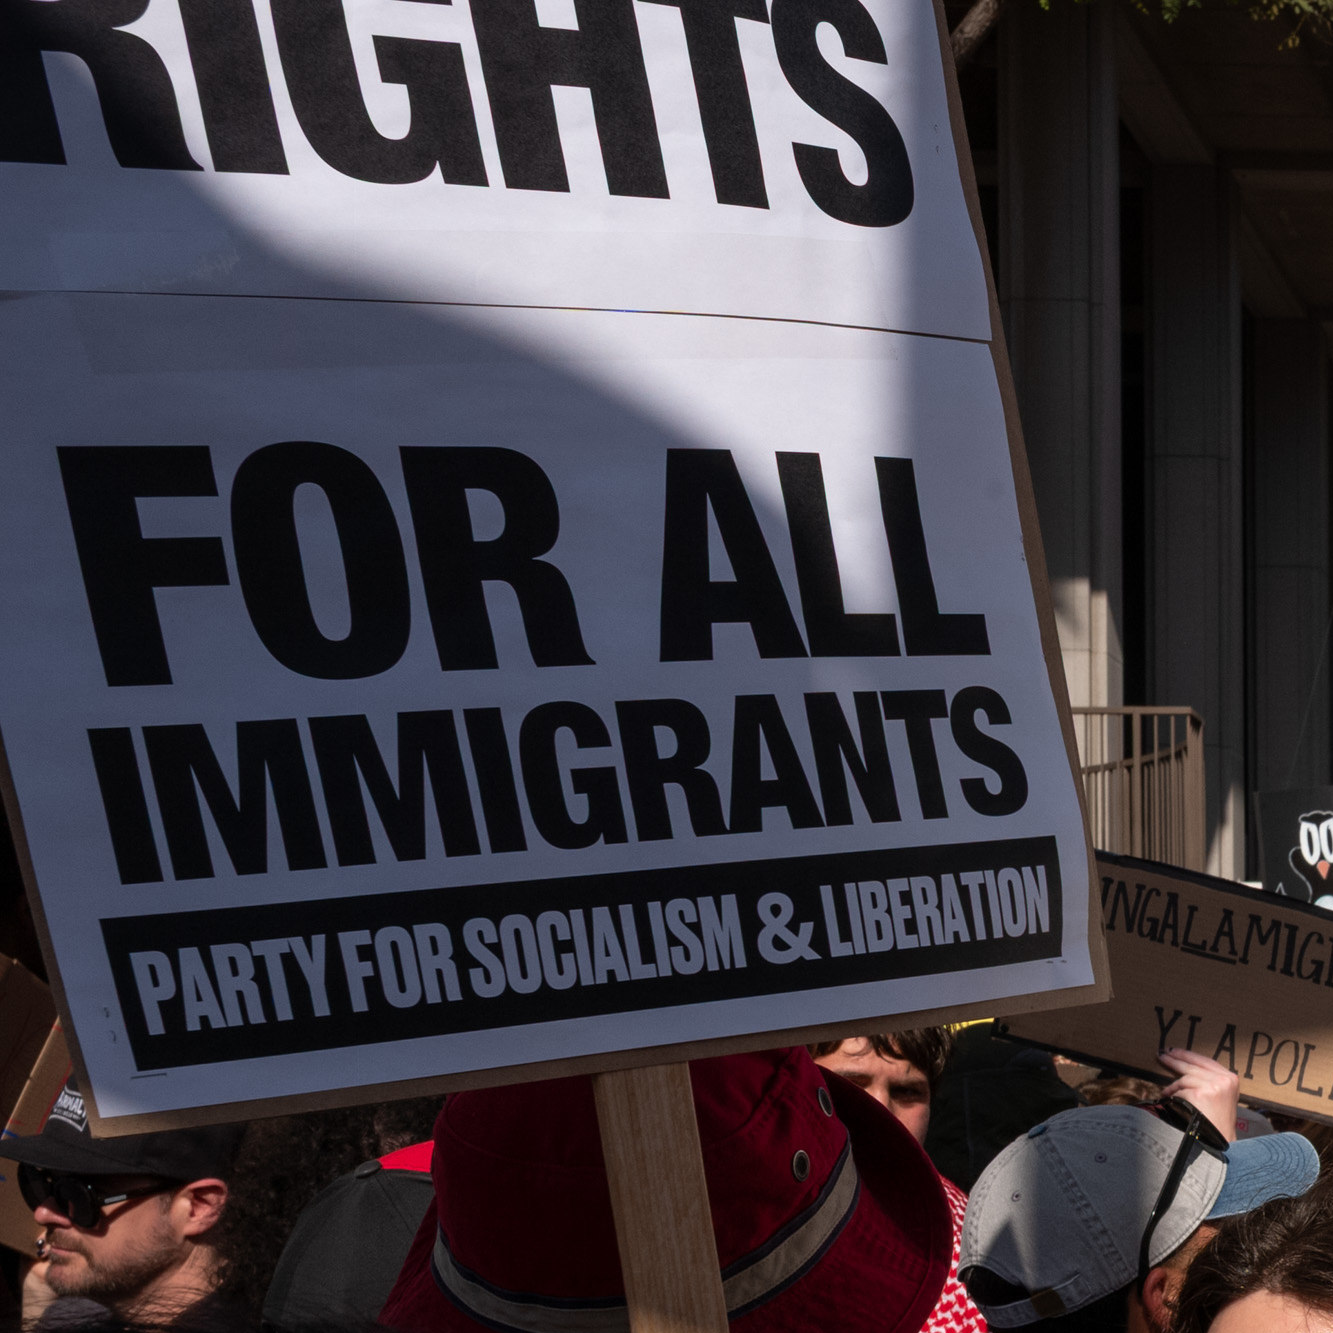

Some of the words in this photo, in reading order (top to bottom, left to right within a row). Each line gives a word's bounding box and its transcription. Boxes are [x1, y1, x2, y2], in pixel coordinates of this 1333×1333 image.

[0, 0, 915, 228] RIGHTS
[56, 440, 596, 687] FOR
[659, 447, 991, 663] ALL
[87, 686, 1029, 885] IMMIGRANTS
[130, 934, 337, 1036] PARTY
[343, 925, 464, 1014] FOR
[469, 892, 747, 998] SOCIALISM
[756, 889, 822, 968] &
[824, 864, 1051, 960] LIBERATION
